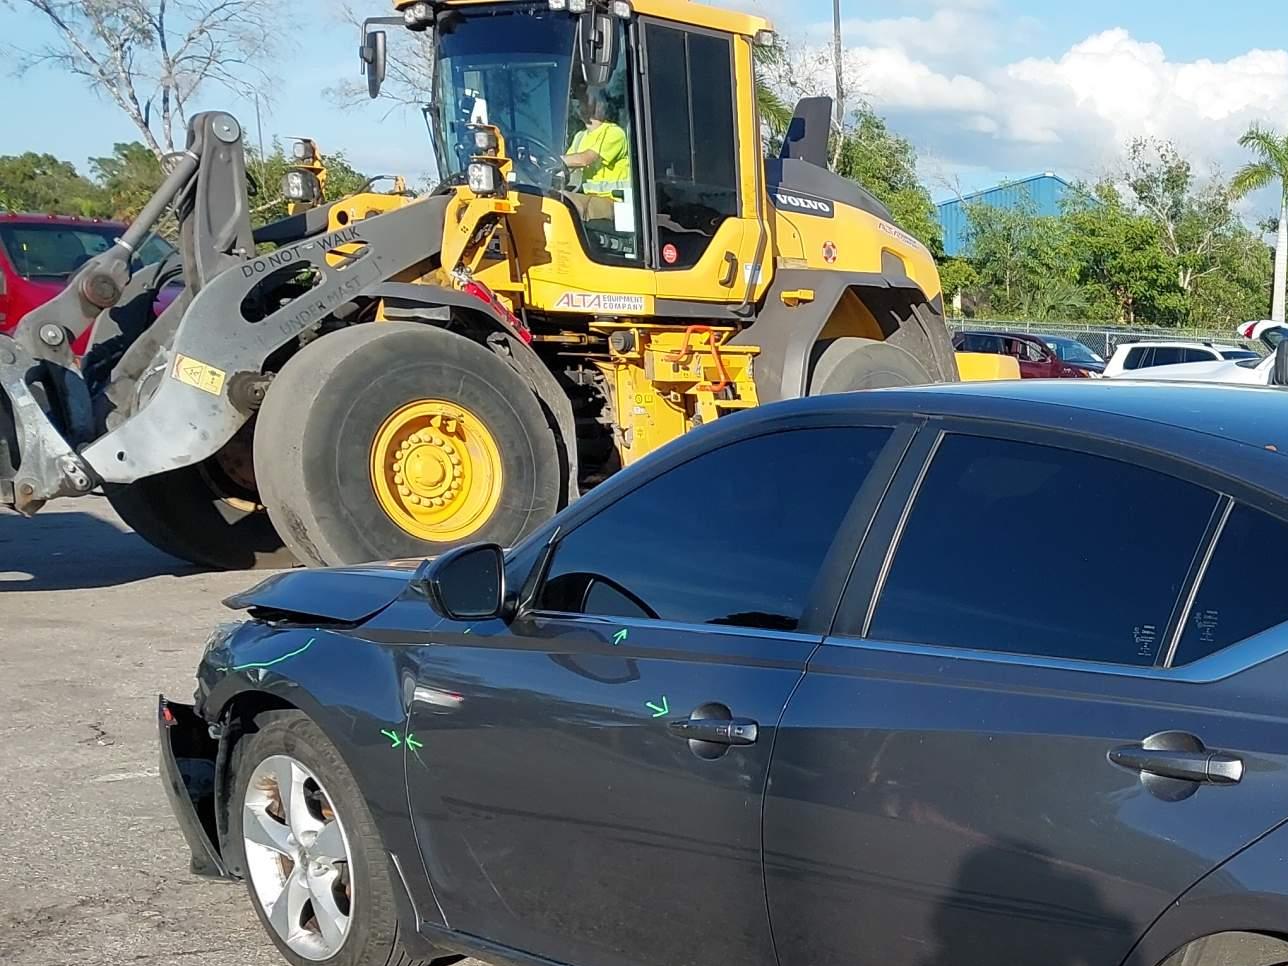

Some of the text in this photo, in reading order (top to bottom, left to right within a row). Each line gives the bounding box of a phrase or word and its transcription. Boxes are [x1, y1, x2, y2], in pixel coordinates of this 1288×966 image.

[776, 193, 830, 213] VOLVO
[241, 225, 361, 278] DO NOT WALK
[279, 276, 361, 335] UNDER MAST
[555, 292, 601, 309] ALTA
[602, 294, 643, 304] EQUIPMENT
[602, 302, 643, 311] COMPANY
